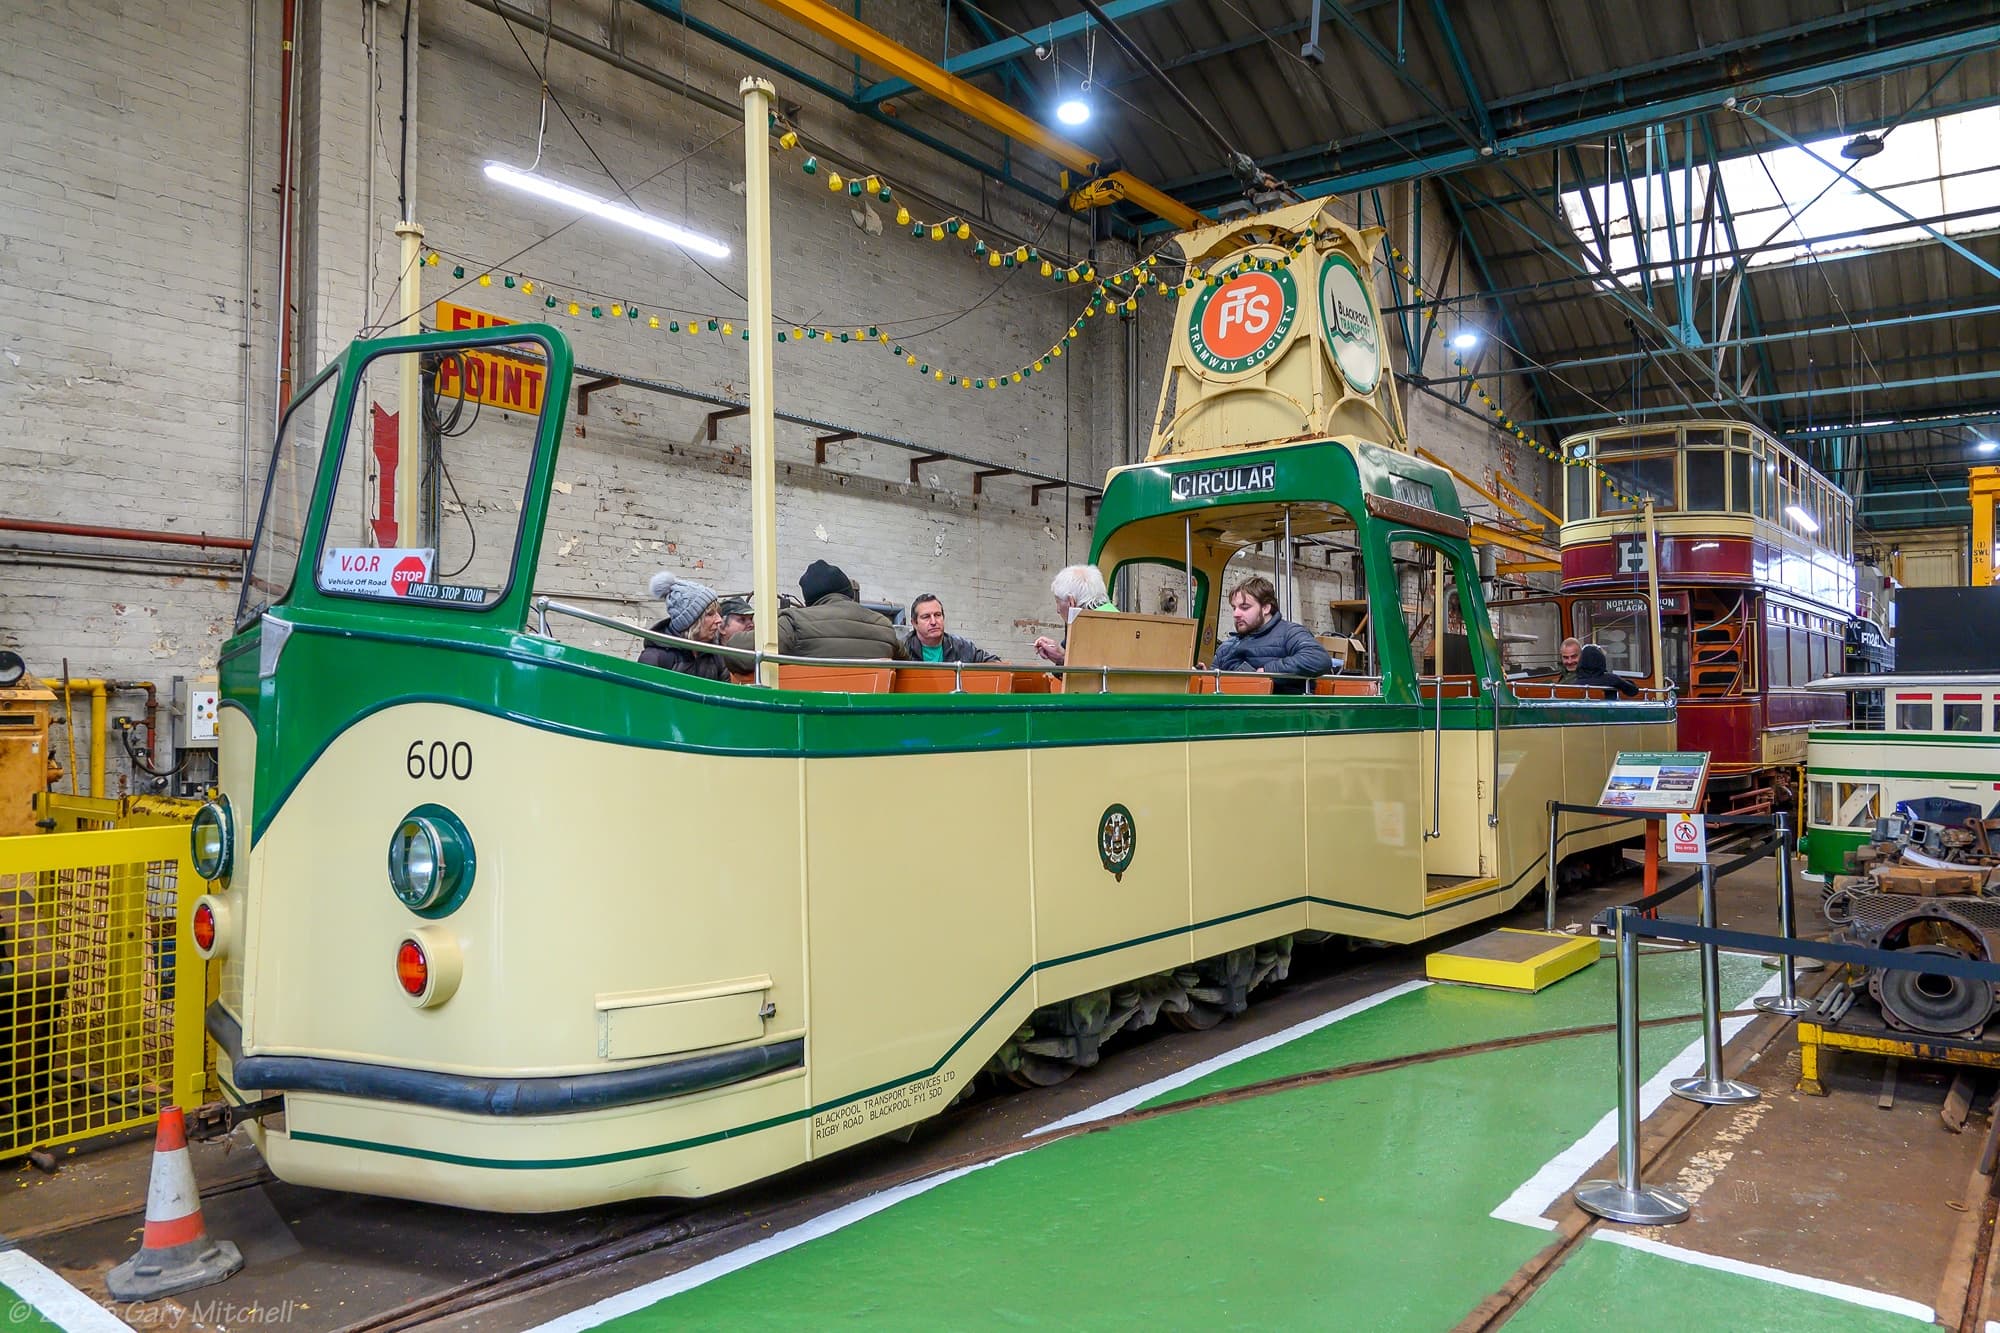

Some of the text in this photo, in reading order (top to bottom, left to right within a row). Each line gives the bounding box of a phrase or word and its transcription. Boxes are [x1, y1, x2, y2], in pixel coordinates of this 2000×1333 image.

[1337, 299, 1370, 327] BLACKPOOL
[1340, 316, 1371, 340] TRANSPORT
[1189, 304, 1295, 371] TRAMWAY SOCIETY
[442, 356, 542, 410] POINT
[1178, 465, 1275, 497] CIRCULAR
[1618, 541, 1649, 573] H
[328, 578, 354, 586] Vehicle
[355, 578, 367, 586] Off
[393, 570, 423, 582] STOP
[408, 583, 484, 602] LIMITED STOP TOUR
[1606, 600, 1634, 610] NORTH
[406, 740, 473, 781] 600
[815, 1070, 955, 1128] BLACKPOOL TRANSPORT SERVICES LTD
[816, 1122, 840, 1140] RIGBY
[843, 1114, 864, 1129] ROAD
[869, 1099, 912, 1121] BLACKPOOL
